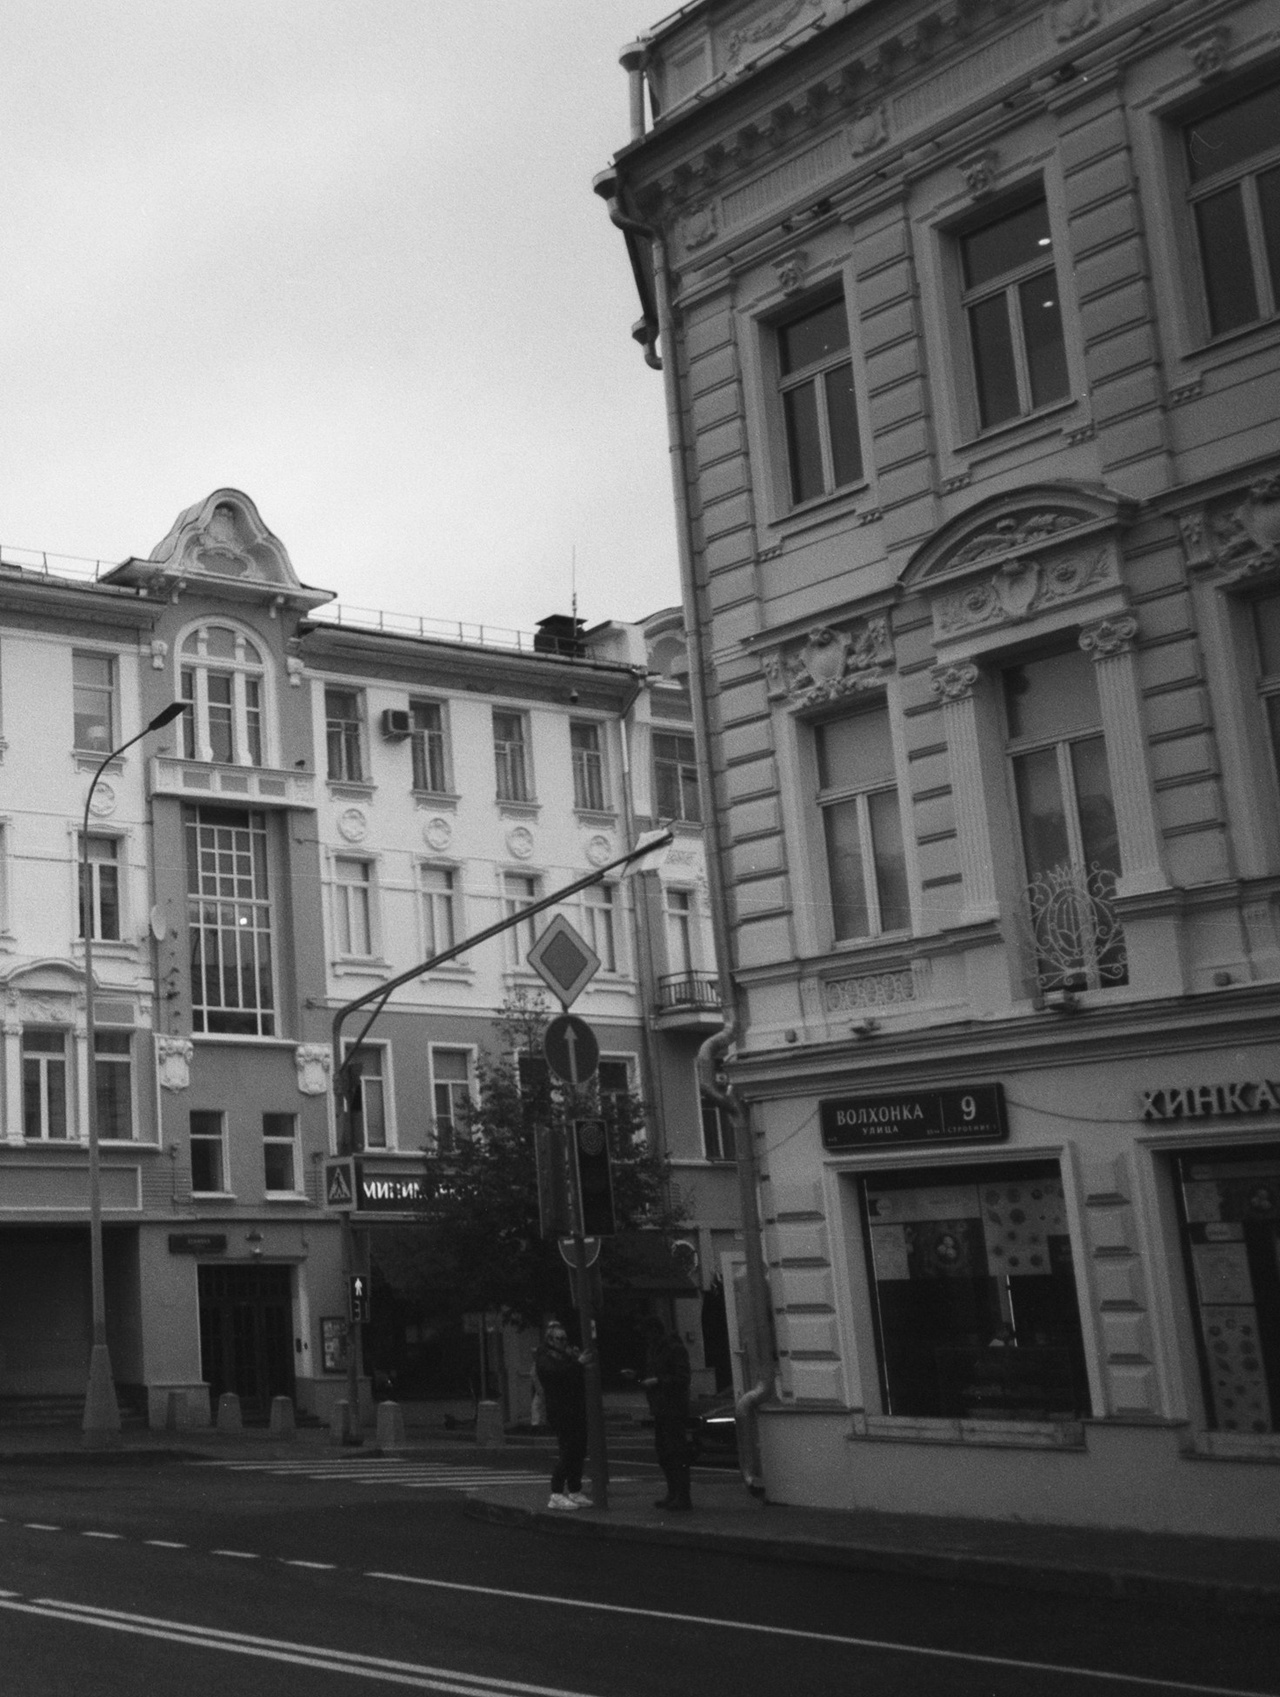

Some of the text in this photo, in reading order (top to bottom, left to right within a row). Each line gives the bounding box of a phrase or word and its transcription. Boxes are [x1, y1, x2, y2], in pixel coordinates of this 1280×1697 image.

[836, 1103, 924, 1126] ВОЛХОНКА
[960, 1095, 977, 1121] 9
[862, 1125, 899, 1135] УЛИЦА
